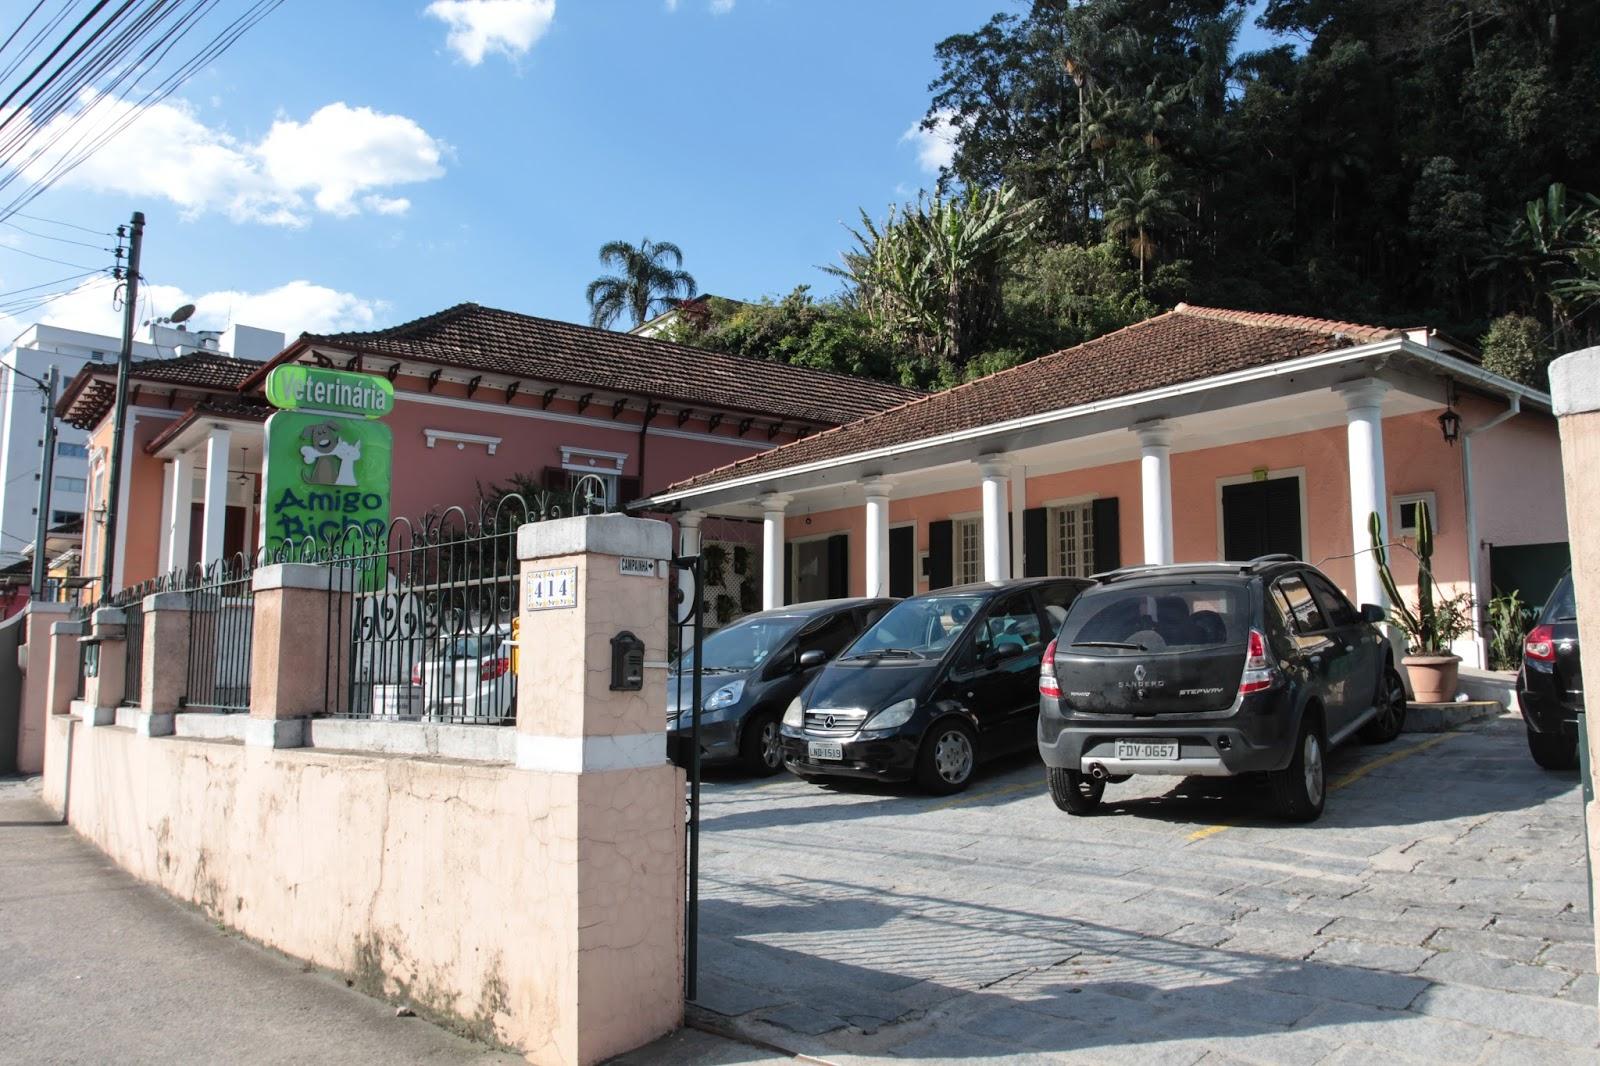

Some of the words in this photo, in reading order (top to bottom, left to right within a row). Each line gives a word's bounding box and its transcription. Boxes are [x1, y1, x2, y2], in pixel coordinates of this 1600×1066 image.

[281, 370, 386, 410] Veterinária
[274, 487, 383, 513] Amigo
[270, 513, 387, 547] Bicho
[621, 558, 649, 572] CAMPAINHA
[534, 579, 568, 598] 414
[1118, 680, 1165, 688] SANDERO
[1179, 687, 1224, 696] STEPWAY
